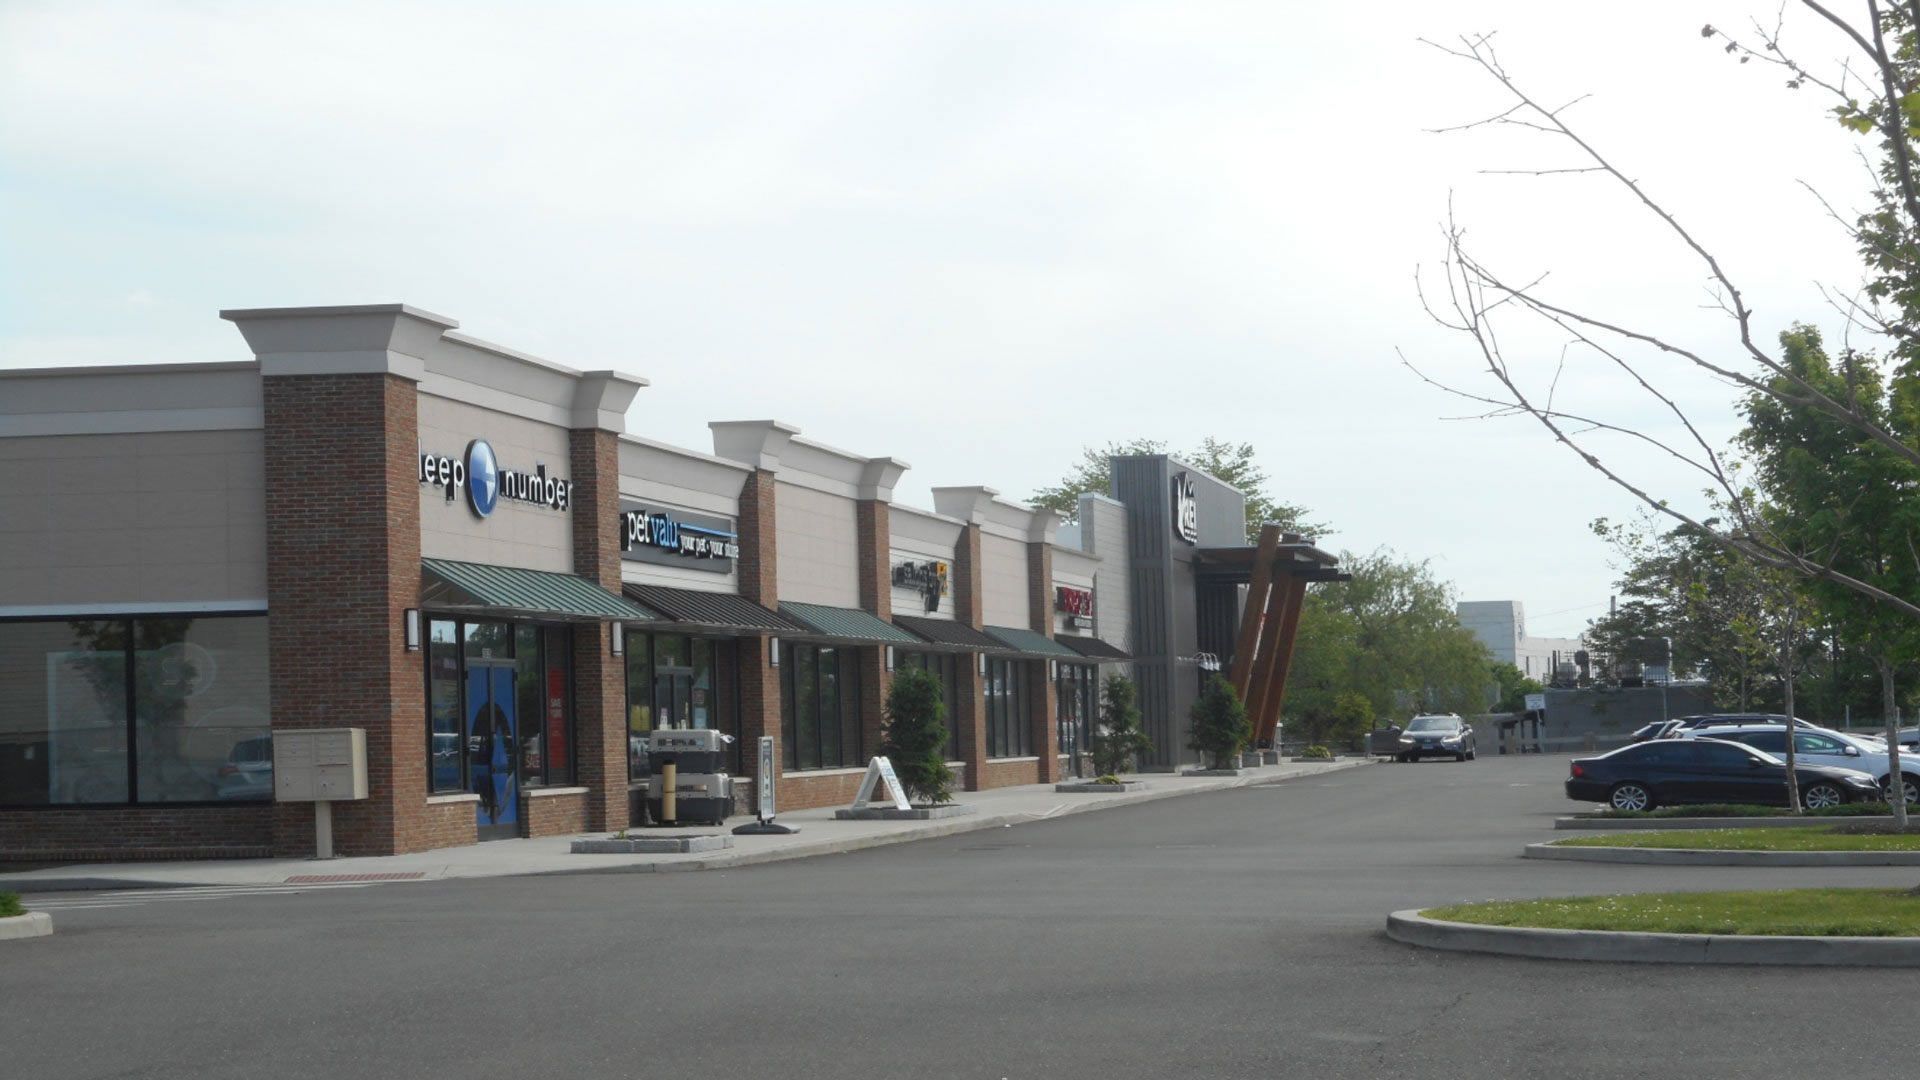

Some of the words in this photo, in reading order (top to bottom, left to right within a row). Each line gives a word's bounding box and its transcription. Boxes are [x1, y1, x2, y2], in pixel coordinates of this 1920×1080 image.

[417, 438, 465, 500] leep
[505, 465, 573, 507] number
[627, 512, 649, 551] pet
[651, 513, 678, 548] valu
[1184, 498, 1197, 530] REI
[680, 535, 695, 554] your
[696, 538, 706, 557] pet
[709, 540, 723, 559] your
